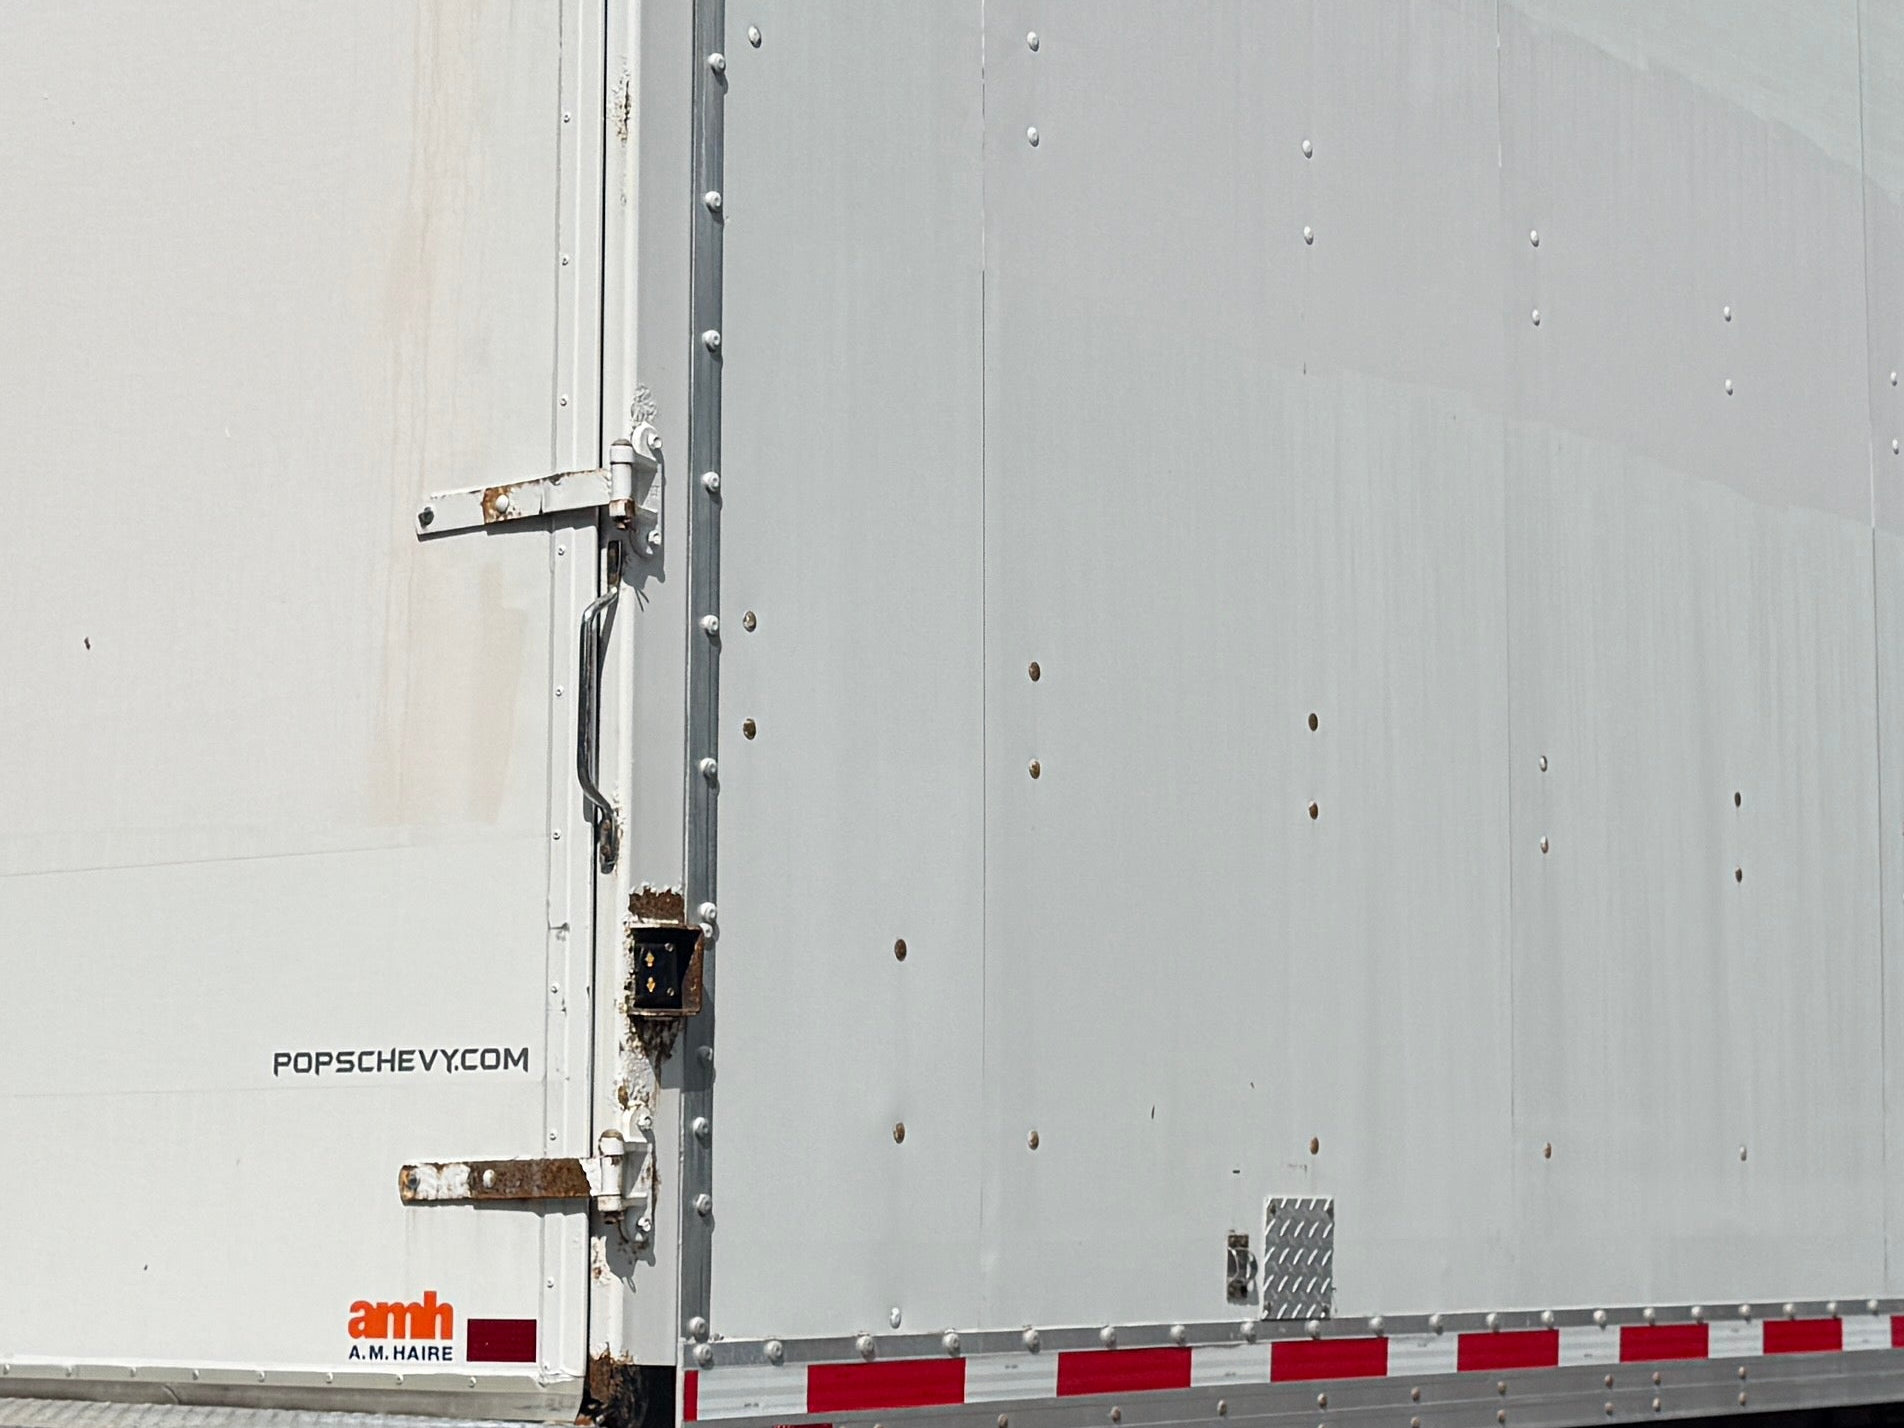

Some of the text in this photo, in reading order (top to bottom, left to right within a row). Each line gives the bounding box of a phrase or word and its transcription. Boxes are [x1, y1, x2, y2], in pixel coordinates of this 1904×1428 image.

[273, 1047, 530, 1076] POPSCHEVY.COM
[348, 1291, 454, 1340] amh
[393, 1345, 454, 1361] HAIRE
